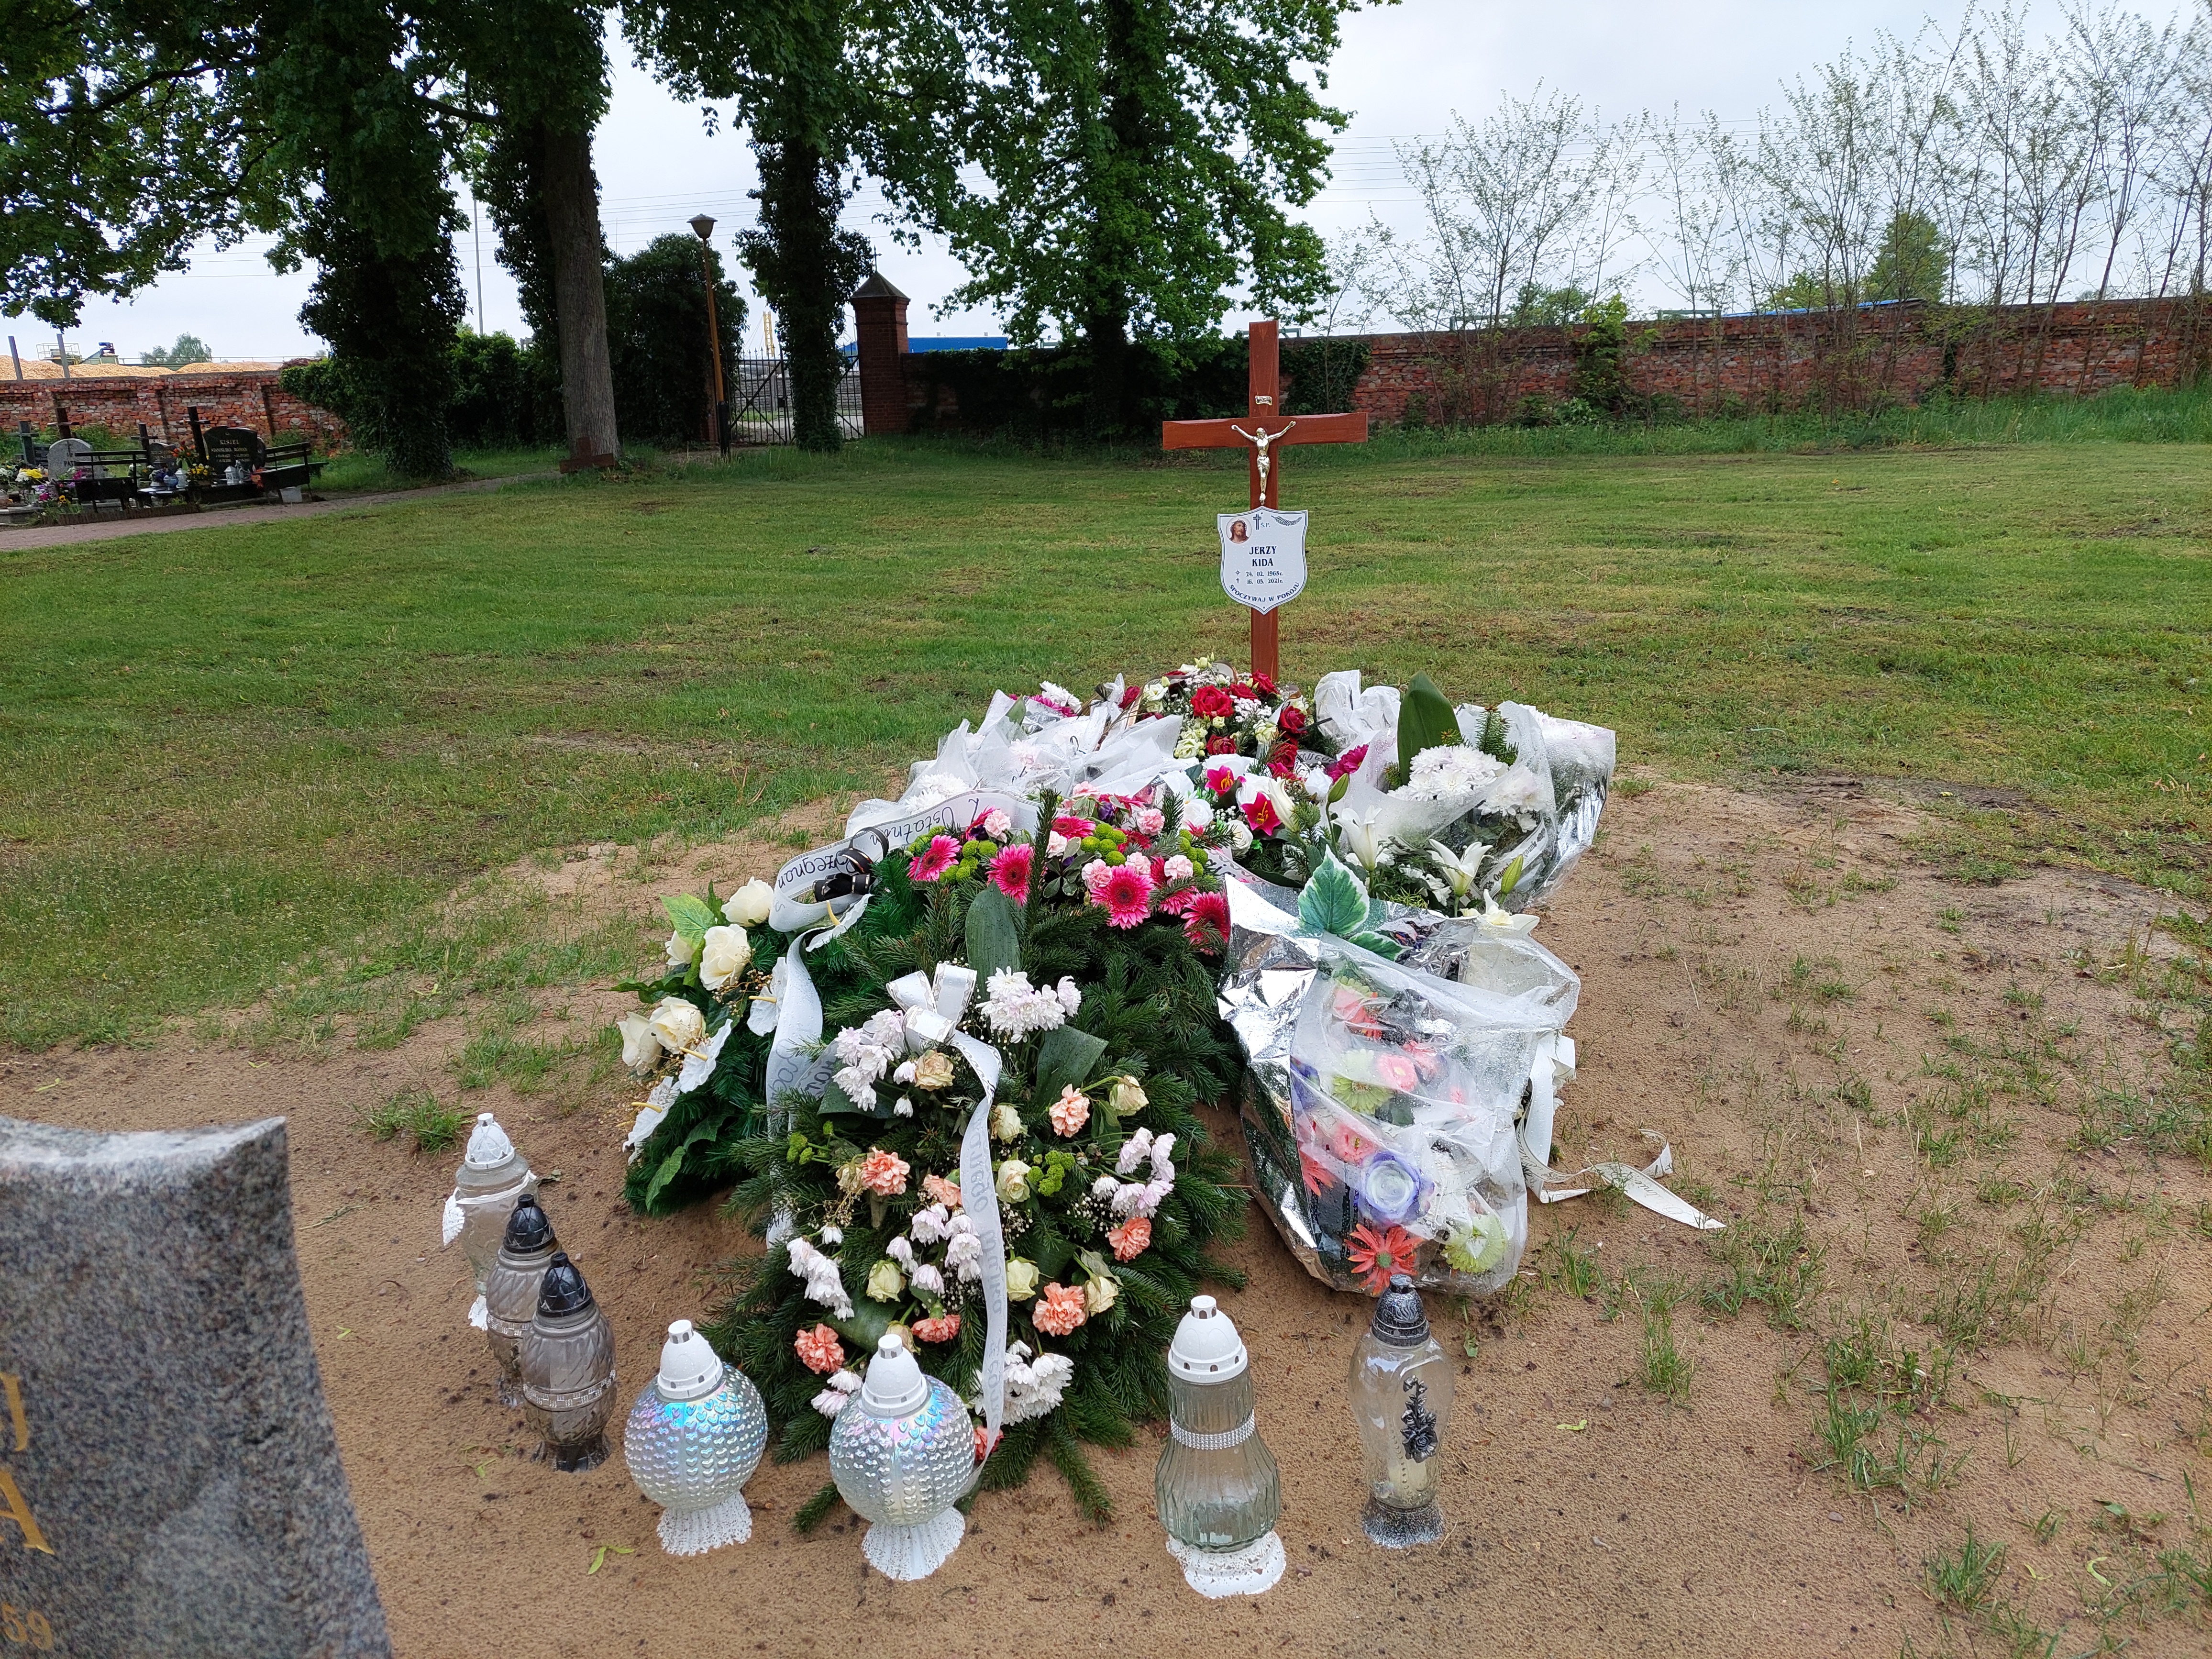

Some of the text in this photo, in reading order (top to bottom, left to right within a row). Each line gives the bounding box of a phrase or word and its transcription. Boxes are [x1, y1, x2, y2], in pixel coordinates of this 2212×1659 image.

[1249, 546, 1277, 554] JERZY
[1252, 558, 1273, 567] KIDA
[1229, 585, 1266, 602] SPOCZYWAJ
[1277, 582, 1300, 600] POKOJU
